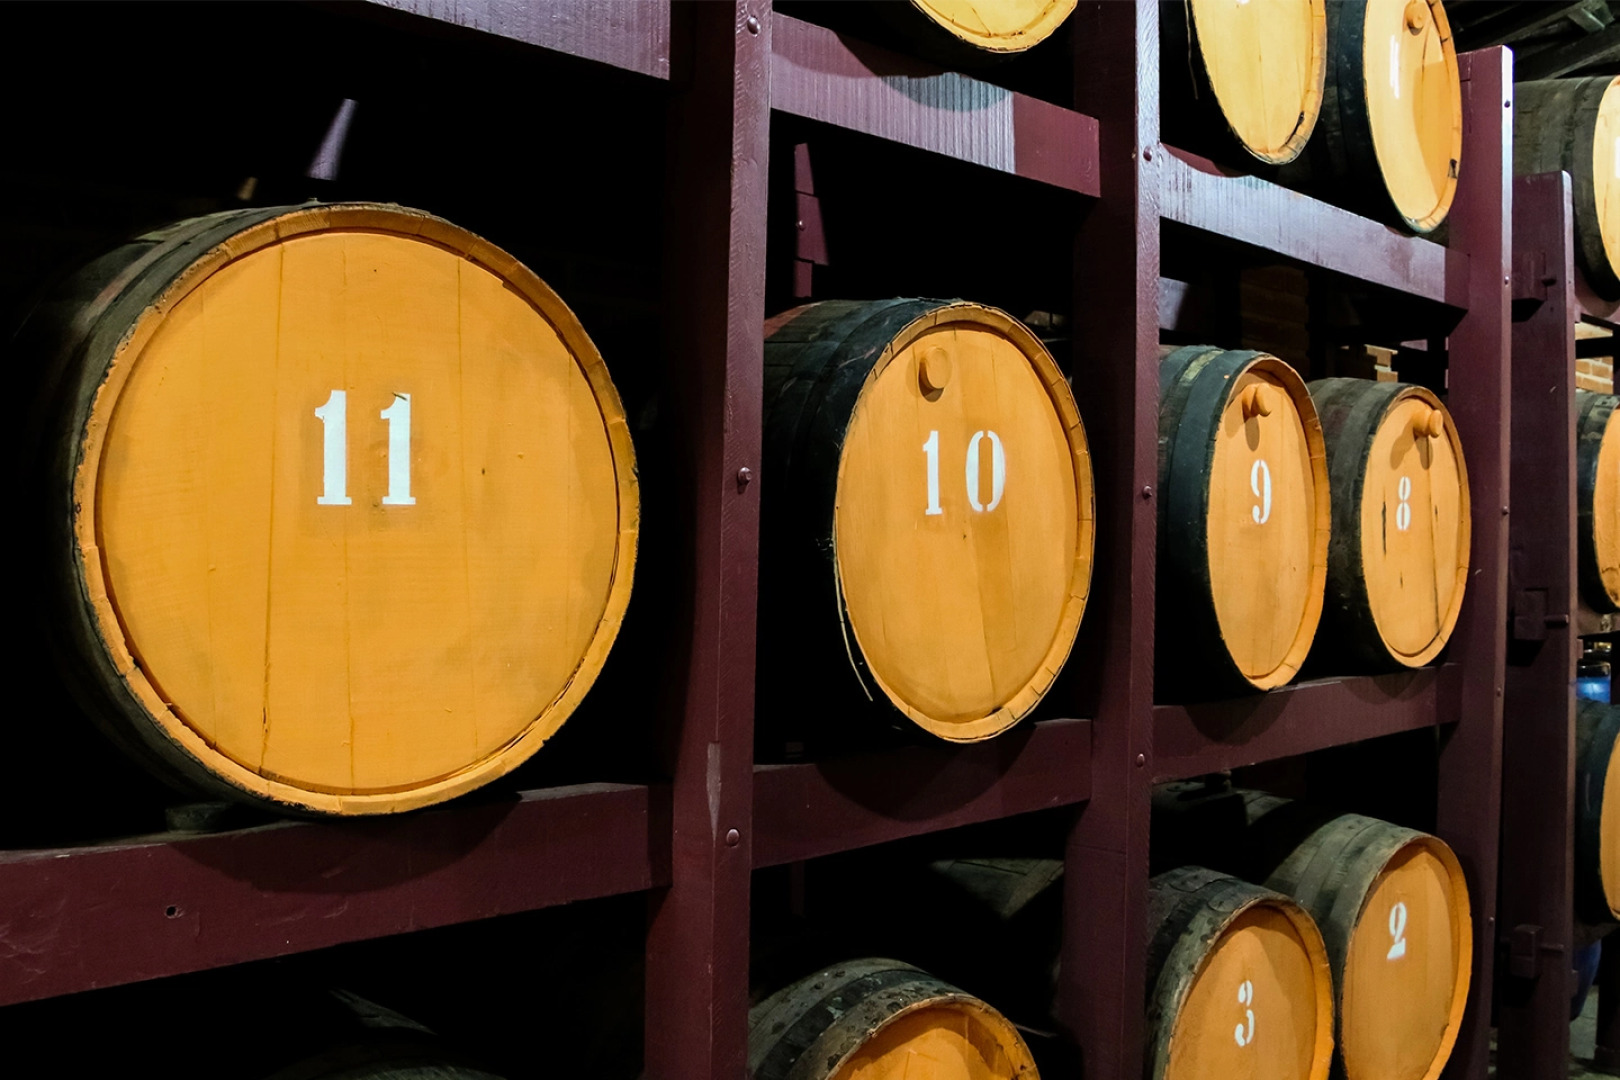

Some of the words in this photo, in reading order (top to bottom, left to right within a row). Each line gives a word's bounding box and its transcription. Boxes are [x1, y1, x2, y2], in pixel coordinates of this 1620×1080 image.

[314, 389, 416, 505] 11
[922, 429, 1006, 515] 10
[1250, 459, 1272, 525] 9
[1396, 475, 1412, 531] 8
[1387, 901, 1408, 960] 2
[1234, 979, 1255, 1047] 3
